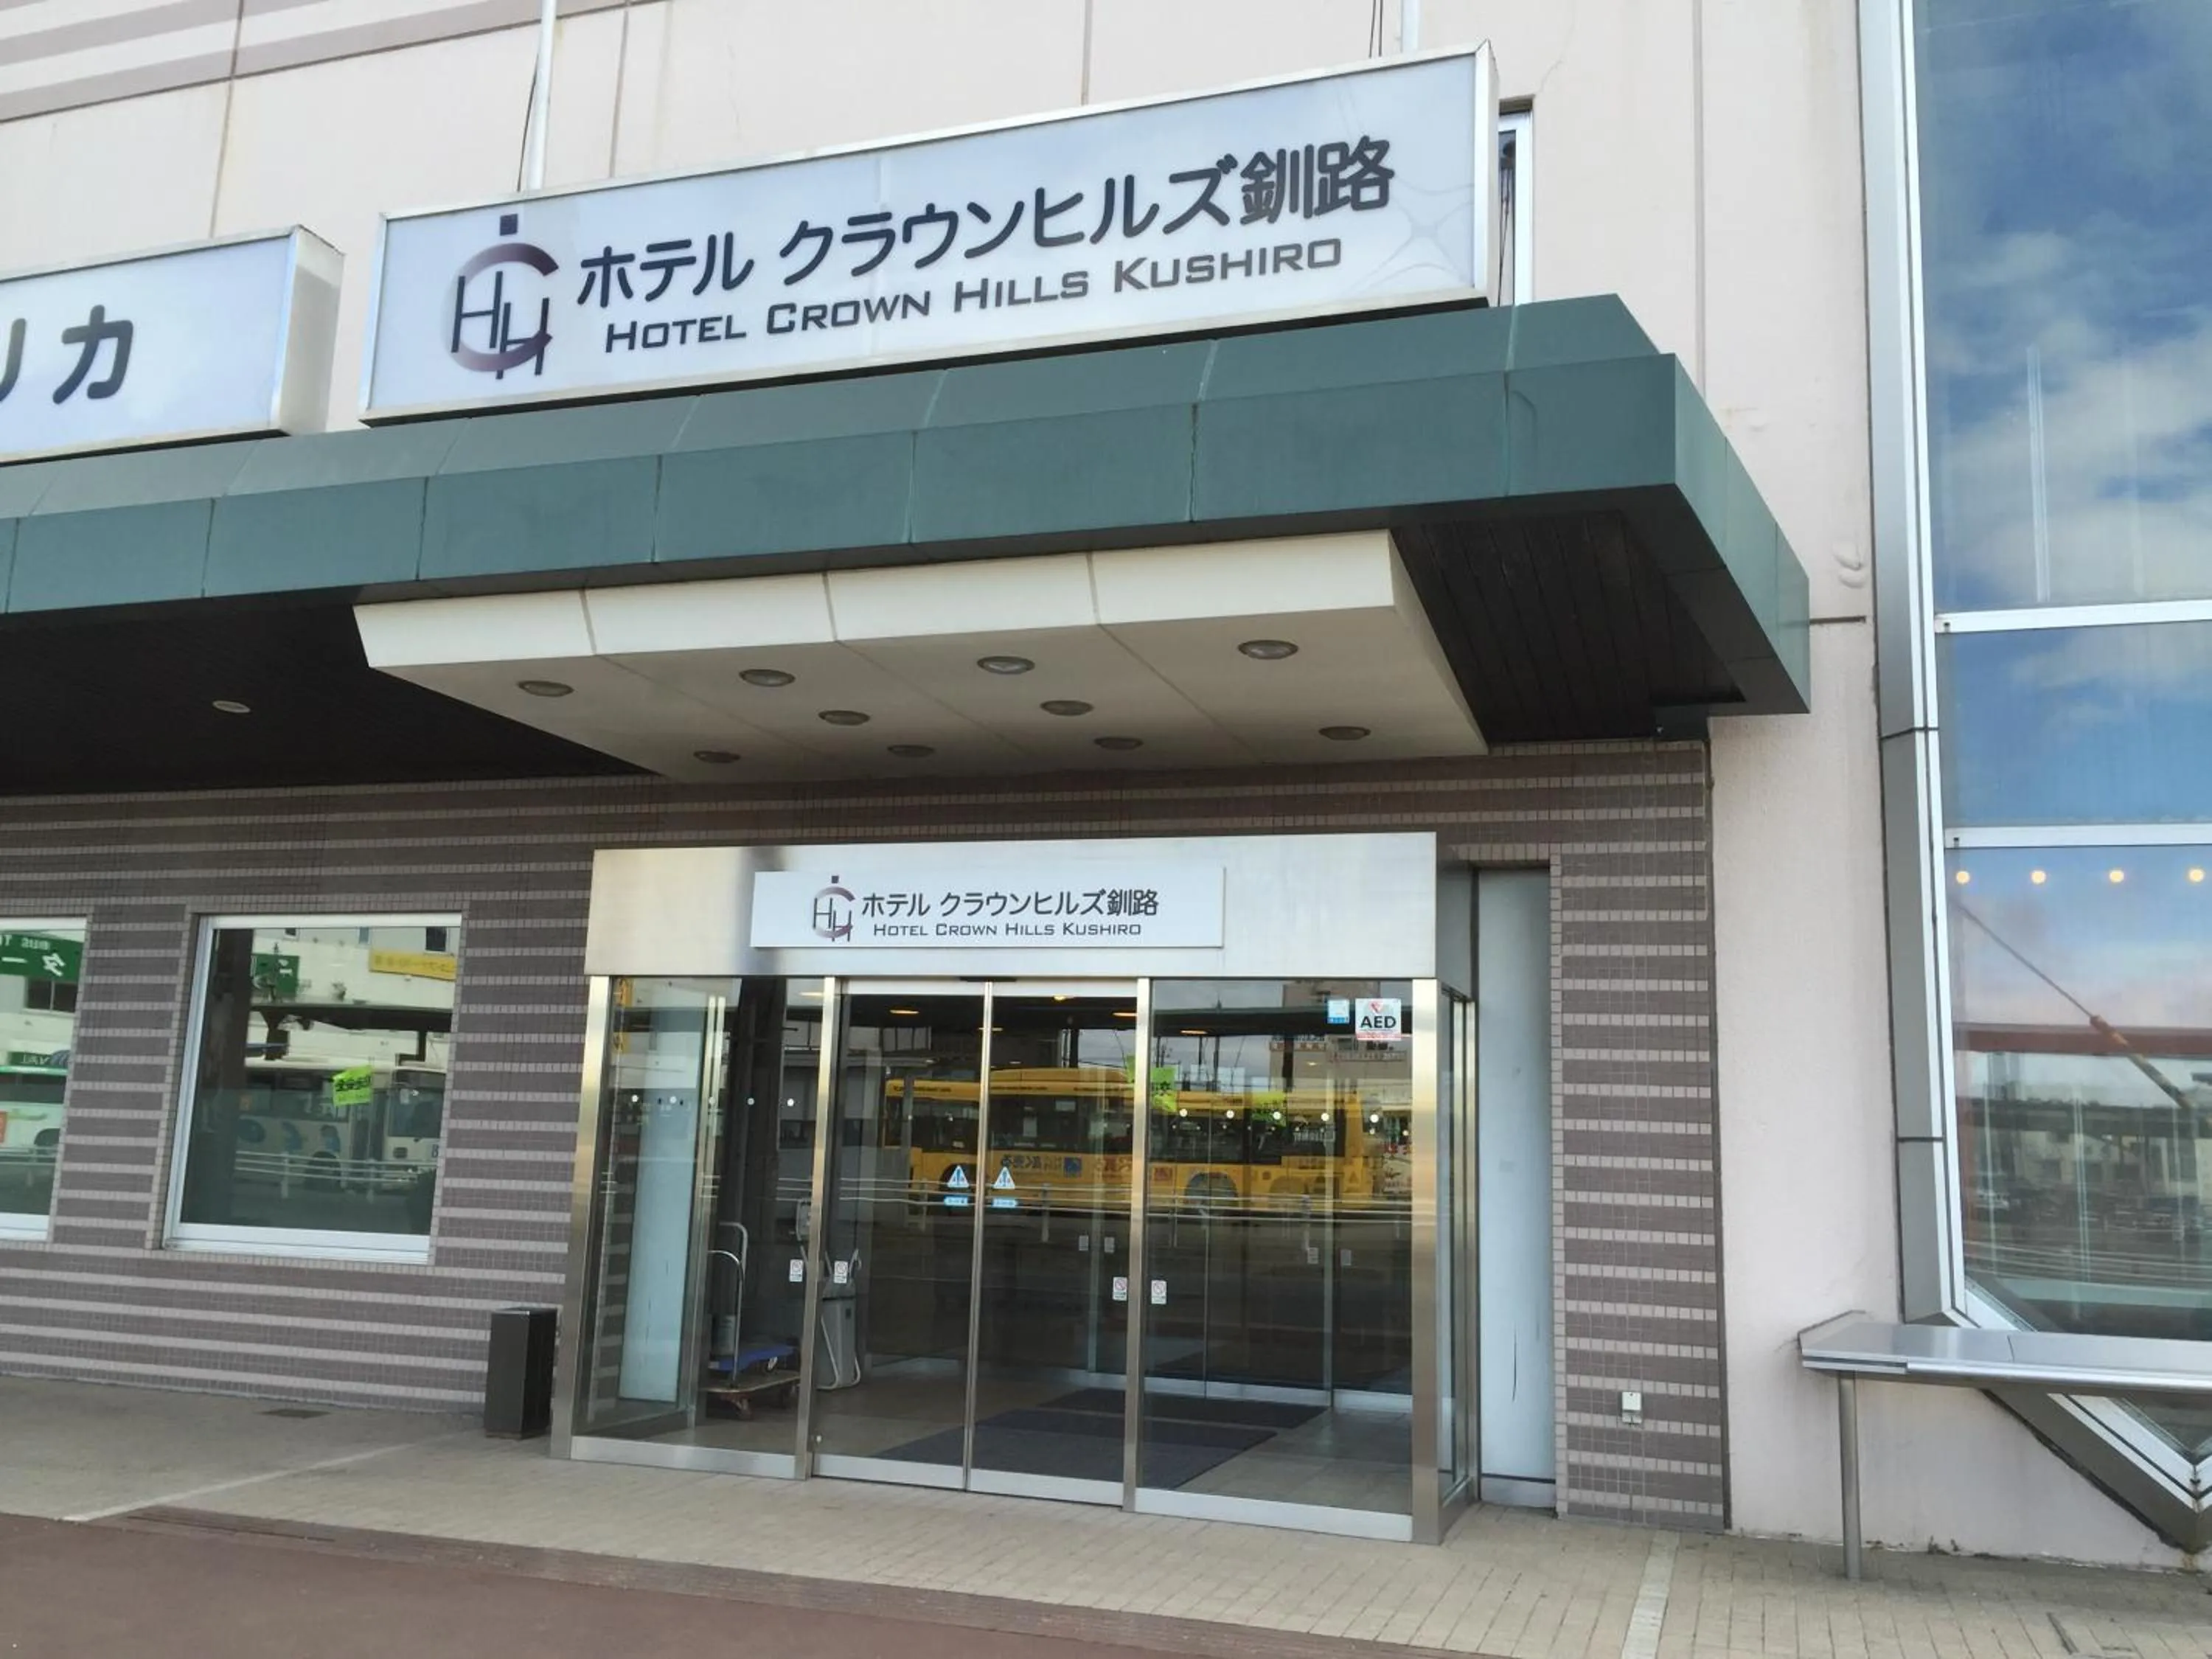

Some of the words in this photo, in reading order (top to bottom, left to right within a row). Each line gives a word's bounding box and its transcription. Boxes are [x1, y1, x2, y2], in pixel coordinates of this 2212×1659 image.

[578, 232, 754, 308] ホテル
[779, 136, 1395, 286] クラウンヒルズ釧路
[605, 314, 747, 354] HOTEL
[766, 291, 931, 335] CROWN
[954, 271, 1089, 313] HILLS
[1114, 237, 1342, 293] KUSHIRO
[862, 892, 931, 917] ホテル
[940, 888, 1159, 917] クラウンヒルズ釧路
[874, 923, 928, 936] HOTEL
[936, 923, 997, 936] CROWN
[1005, 922, 1054, 936] HILLS
[1062, 922, 1141, 936] KUSHIRO
[1360, 1015, 1397, 1029] AED
